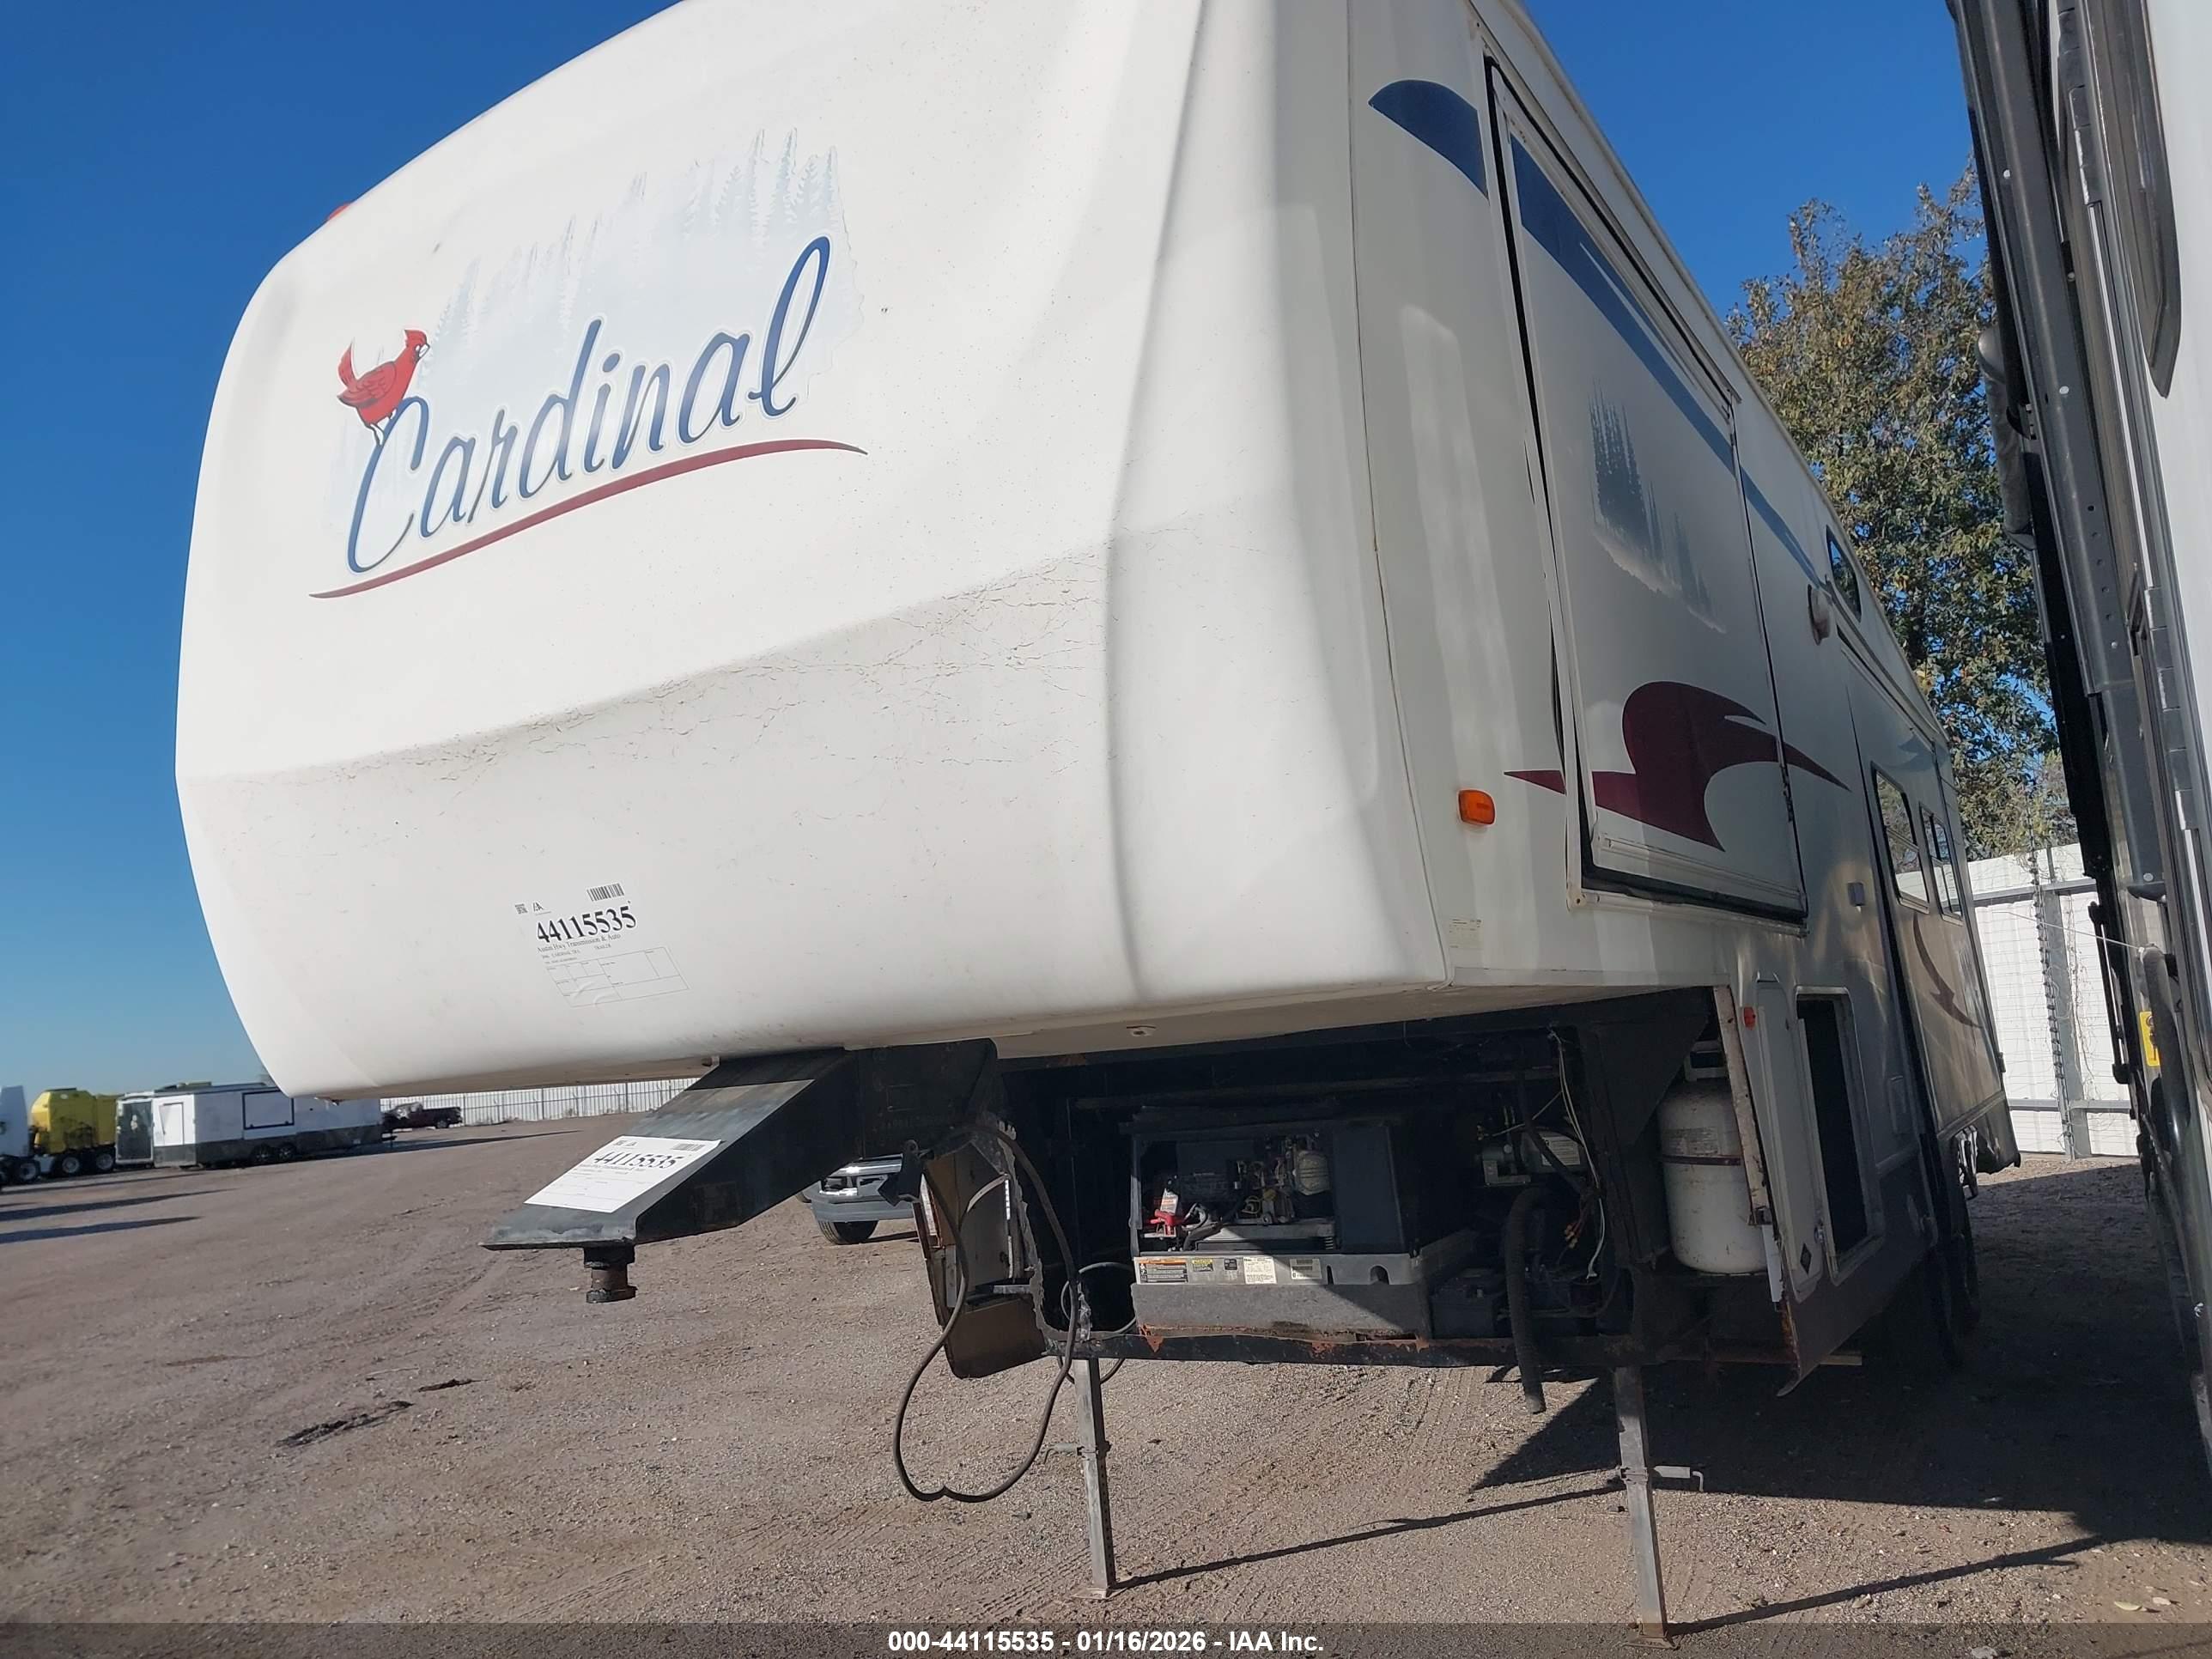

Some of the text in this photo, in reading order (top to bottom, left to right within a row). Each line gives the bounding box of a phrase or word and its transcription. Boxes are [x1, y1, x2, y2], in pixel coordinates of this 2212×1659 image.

[348, 236, 830, 573] Cardinal
[537, 905, 636, 943] 44115535
[607, 933, 622, 941] Auto
[593, 1151, 685, 1169] 44115535
